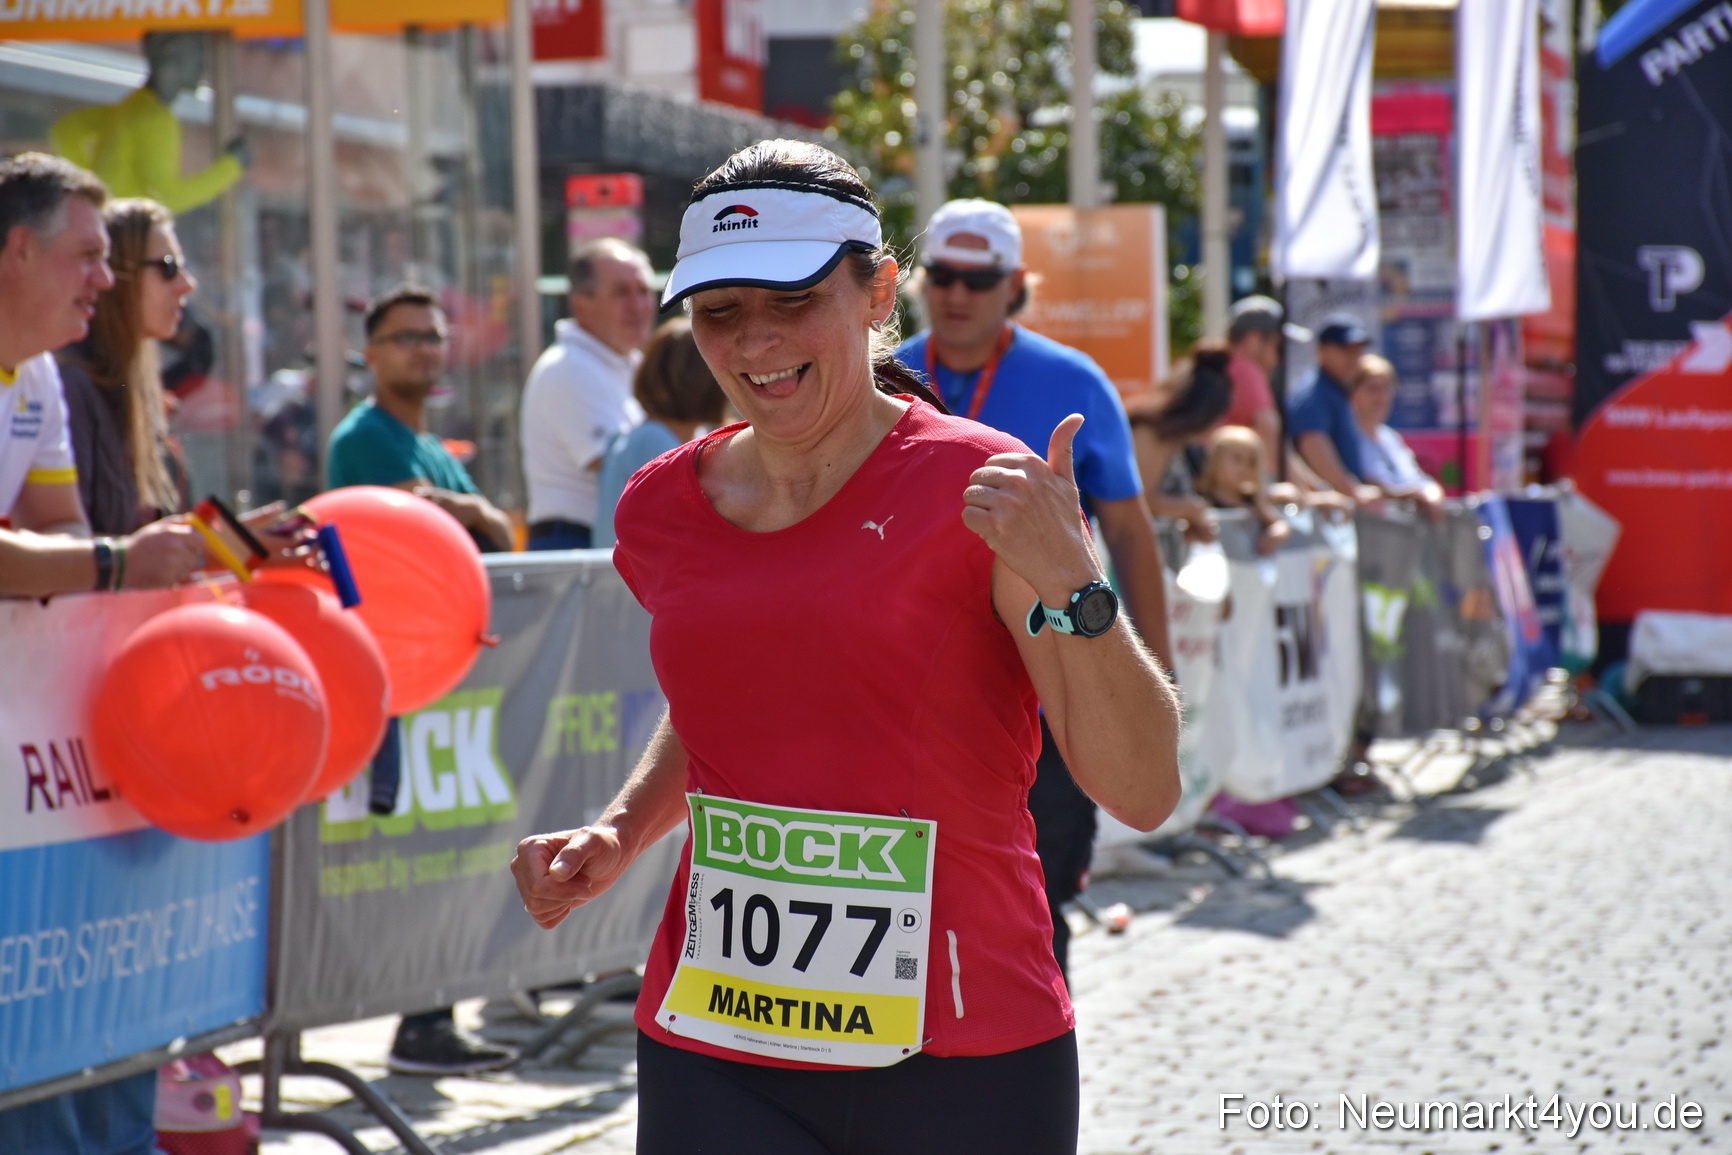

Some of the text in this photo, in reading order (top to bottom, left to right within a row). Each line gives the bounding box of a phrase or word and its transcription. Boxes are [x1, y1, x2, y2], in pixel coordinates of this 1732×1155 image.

[712, 218, 759, 233] skinfit
[707, 811, 898, 877] BOCK
[710, 888, 892, 978] 1077
[903, 914, 916, 927] D
[708, 984, 874, 1035] MARTINA
